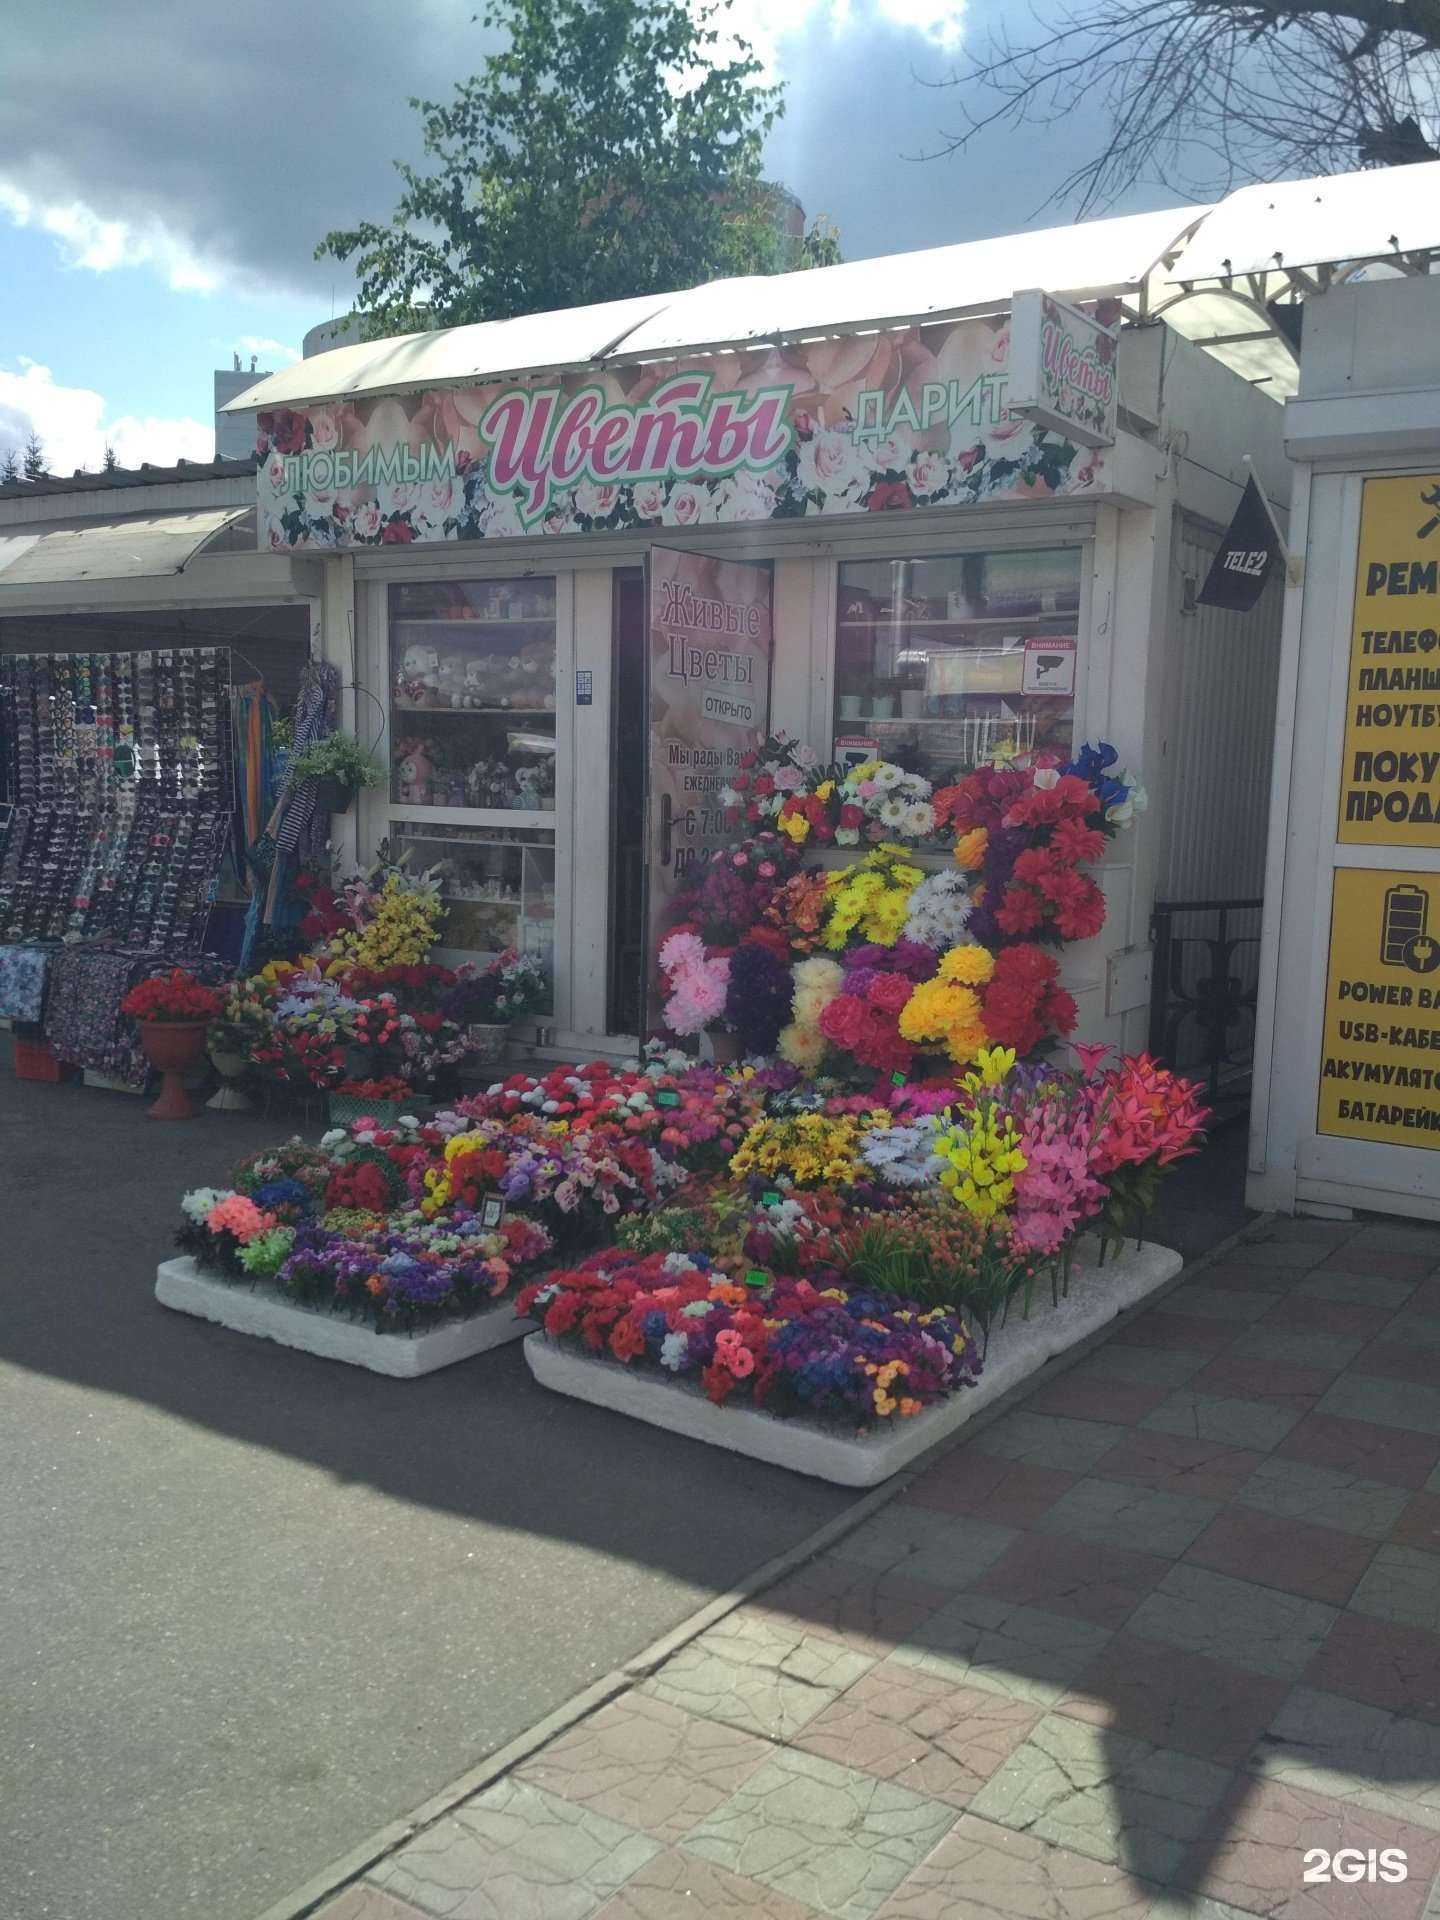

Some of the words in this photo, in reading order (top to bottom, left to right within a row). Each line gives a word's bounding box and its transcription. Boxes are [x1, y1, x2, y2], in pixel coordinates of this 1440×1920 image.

[280, 441, 457, 494] ЛЮБИМЫМ
[480, 374, 793, 524] Цветы
[852, 373, 1024, 447] ДАРИТ
[1223, 551, 1268, 576] TELE2
[1366, 561, 1440, 596] РЕМ
[662, 580, 761, 636] Живые
[1361, 629, 1440, 654] ТЕЛЕФ
[668, 634, 754, 688] Цветы
[705, 697, 752, 720] ОТКРЫТО
[1355, 703, 1440, 728] НОУТБ
[669, 744, 689, 765] Мы
[693, 750, 723, 769] рады
[1338, 980, 1414, 1008] POWER
